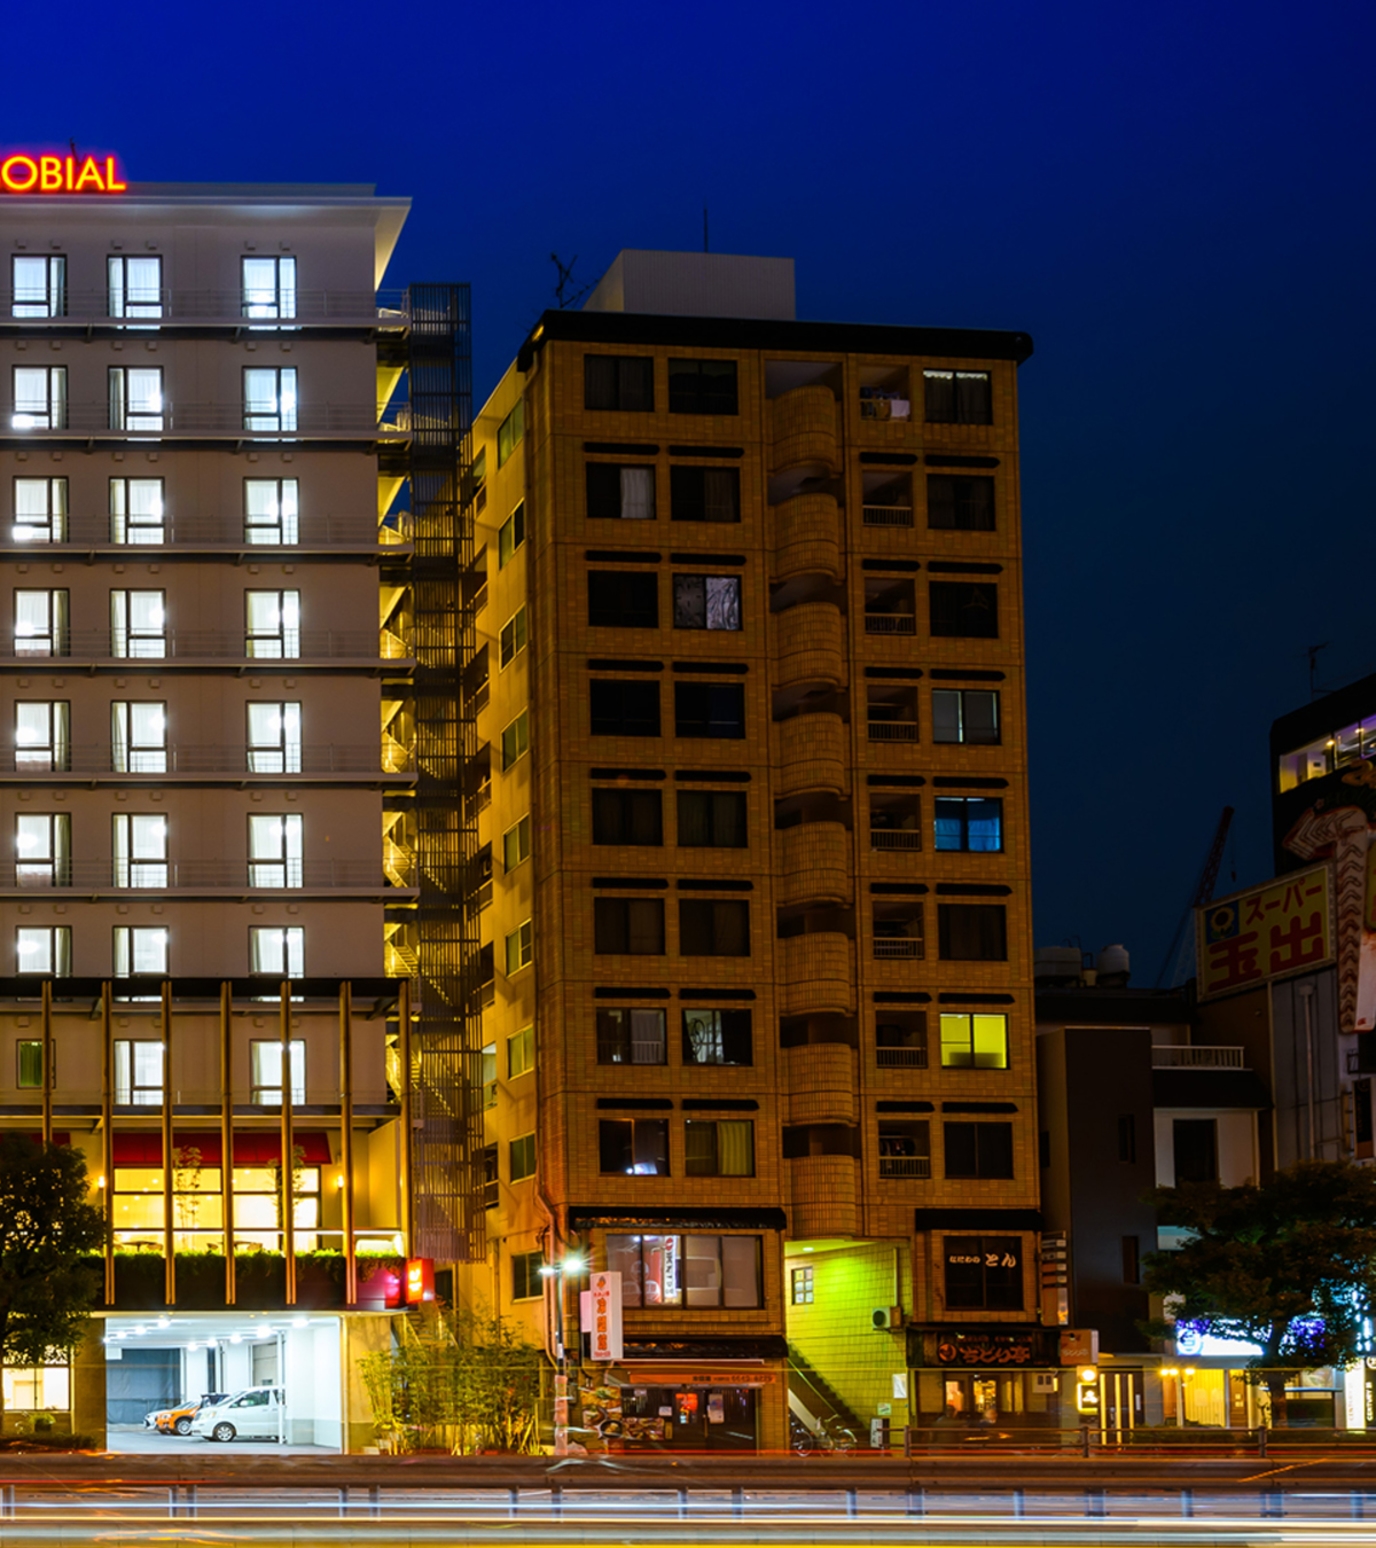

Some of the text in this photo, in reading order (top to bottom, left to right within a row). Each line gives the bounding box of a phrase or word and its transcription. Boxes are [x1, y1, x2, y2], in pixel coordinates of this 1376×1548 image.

[1244, 877, 1323, 926] スーパー
[1208, 911, 1324, 992] 玉出
